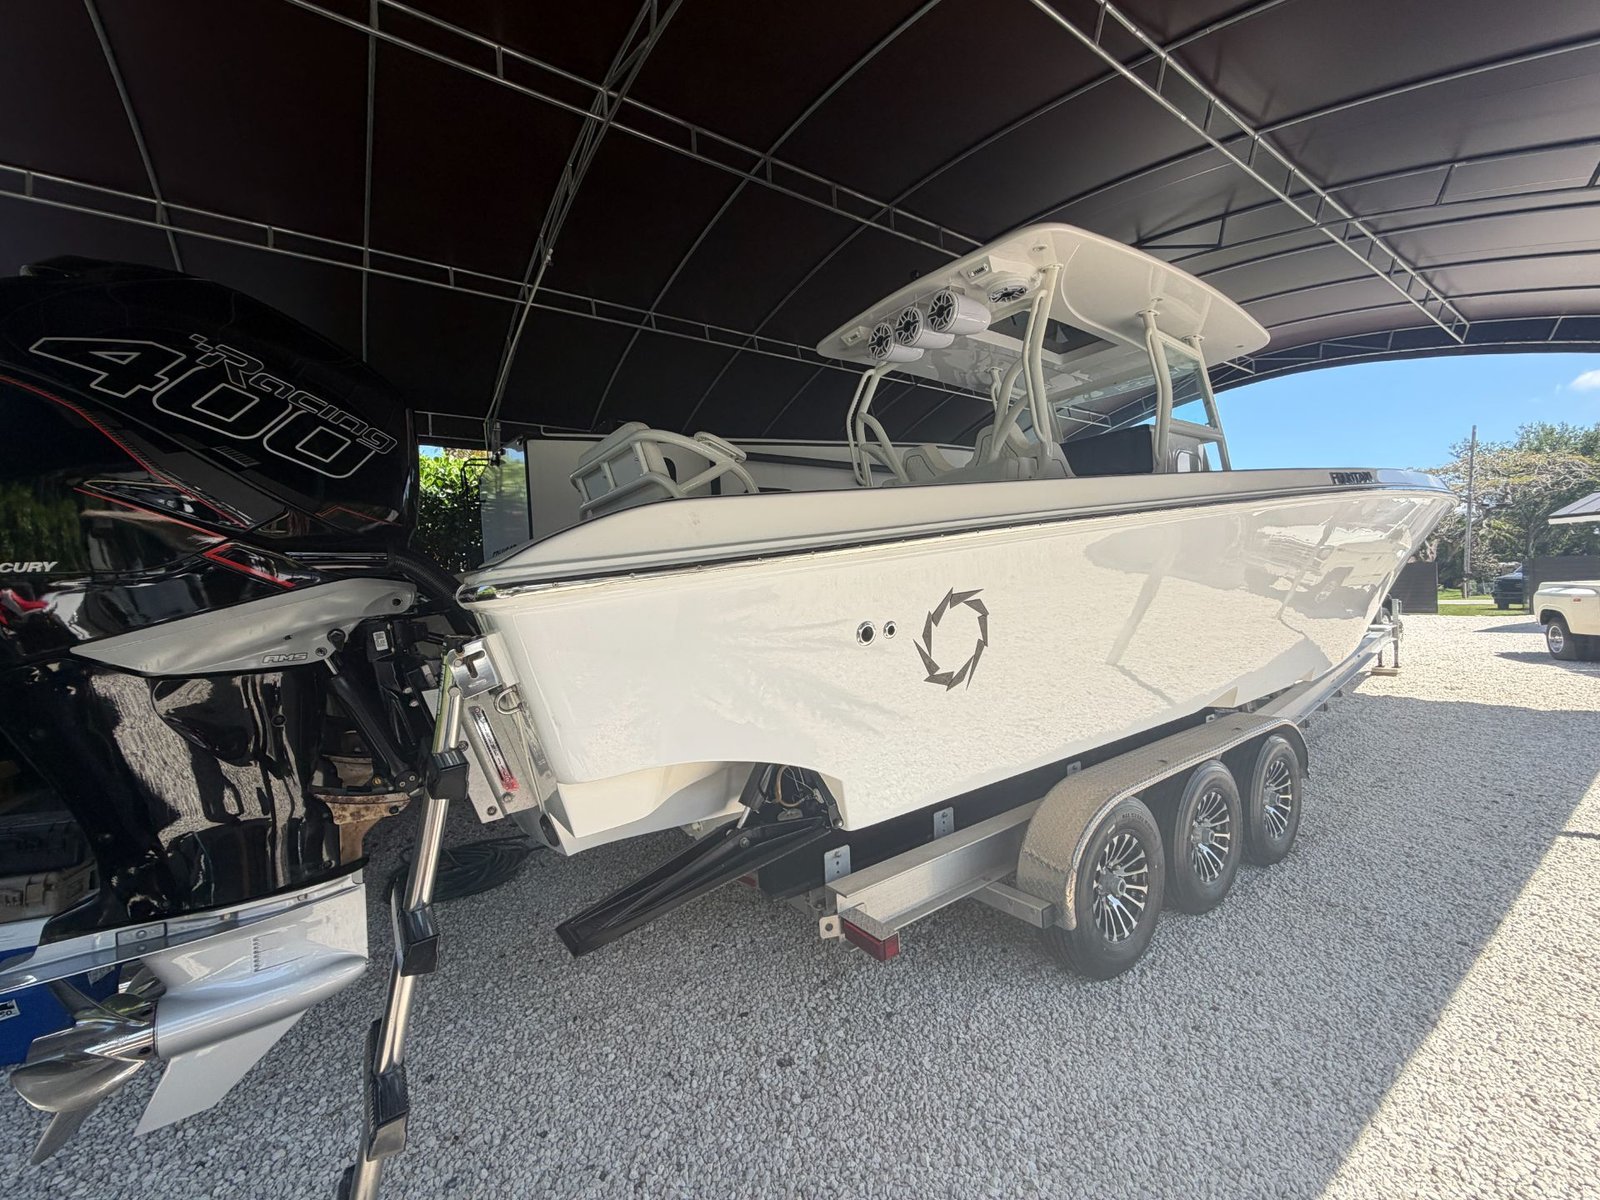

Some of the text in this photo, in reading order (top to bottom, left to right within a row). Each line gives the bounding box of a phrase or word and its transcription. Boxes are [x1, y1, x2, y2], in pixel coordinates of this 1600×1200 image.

[29, 337, 376, 479] 400
[189, 334, 398, 455] Racing
[262, 652, 308, 664] AMS
